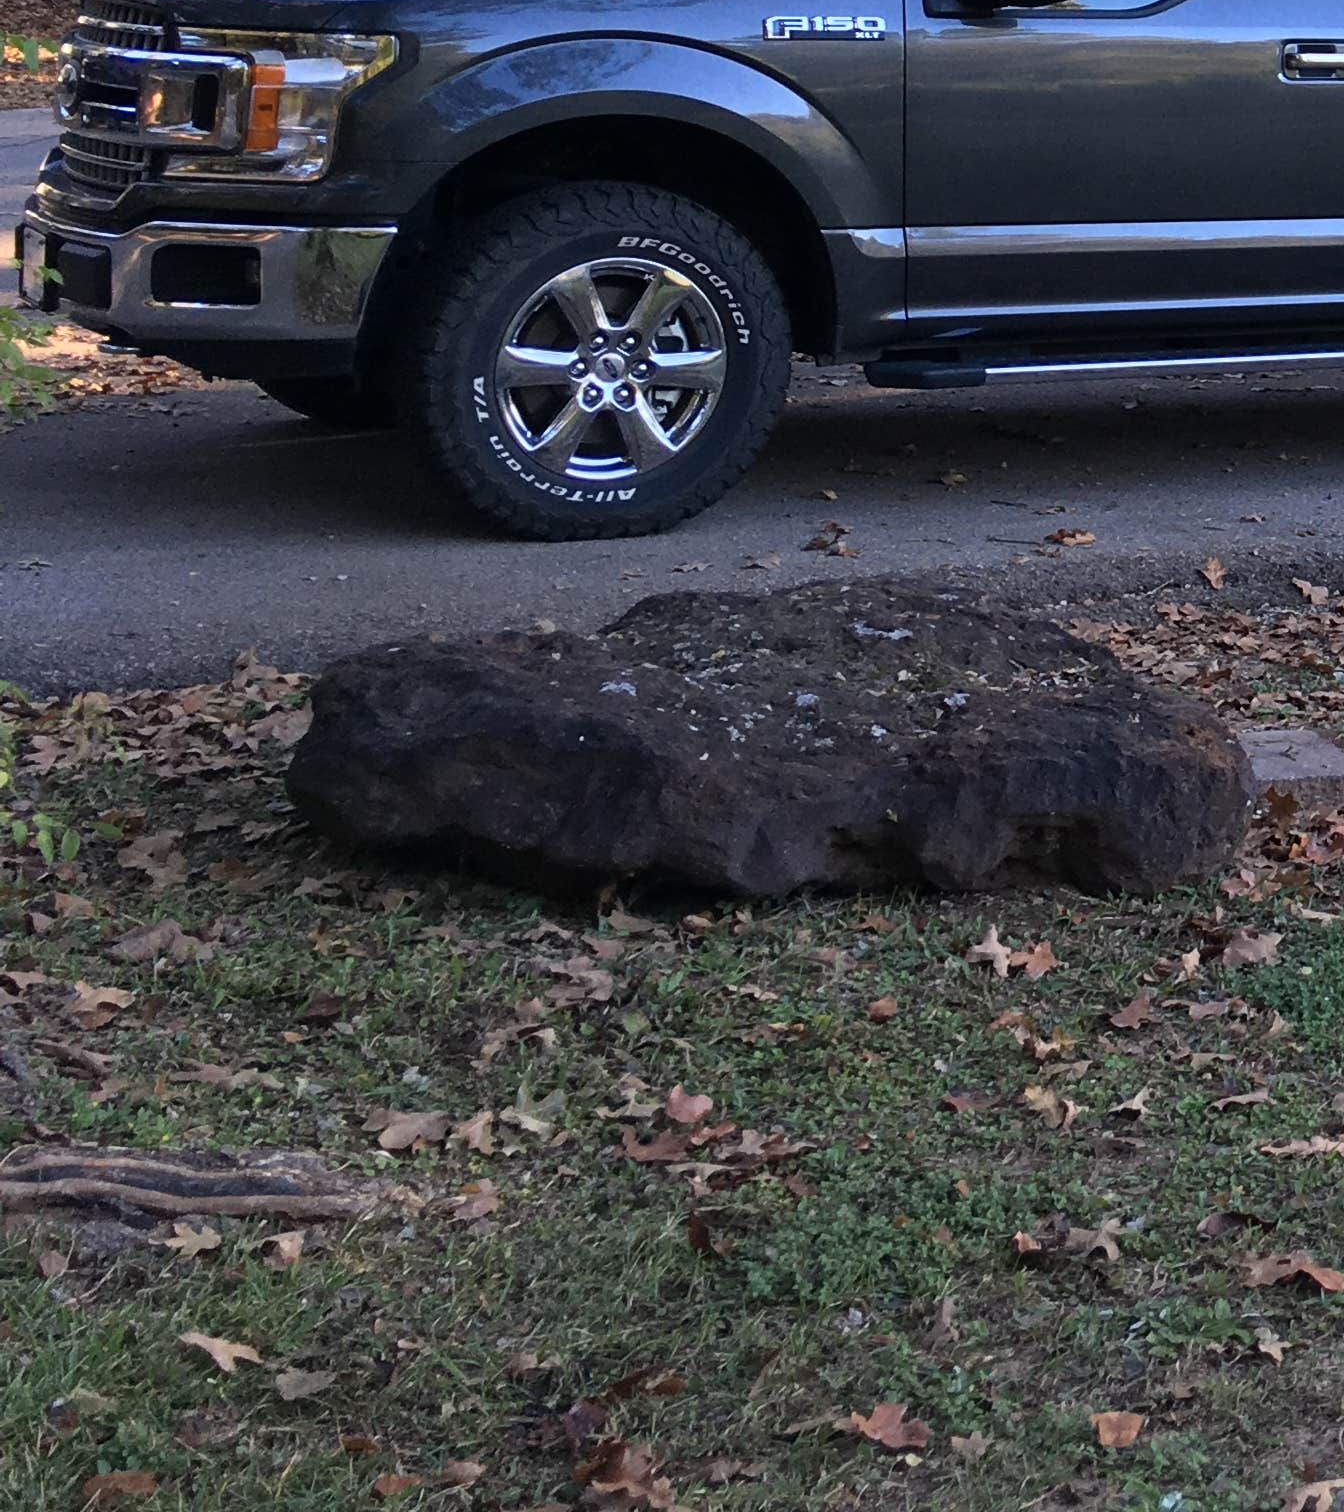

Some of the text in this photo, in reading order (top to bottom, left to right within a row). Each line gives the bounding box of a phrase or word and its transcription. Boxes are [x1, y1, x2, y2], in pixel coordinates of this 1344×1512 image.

[855, 31, 880, 39] XLT
[617, 236, 751, 345] BFGoodrich
[473, 376, 637, 502] All-Terrain T/A
